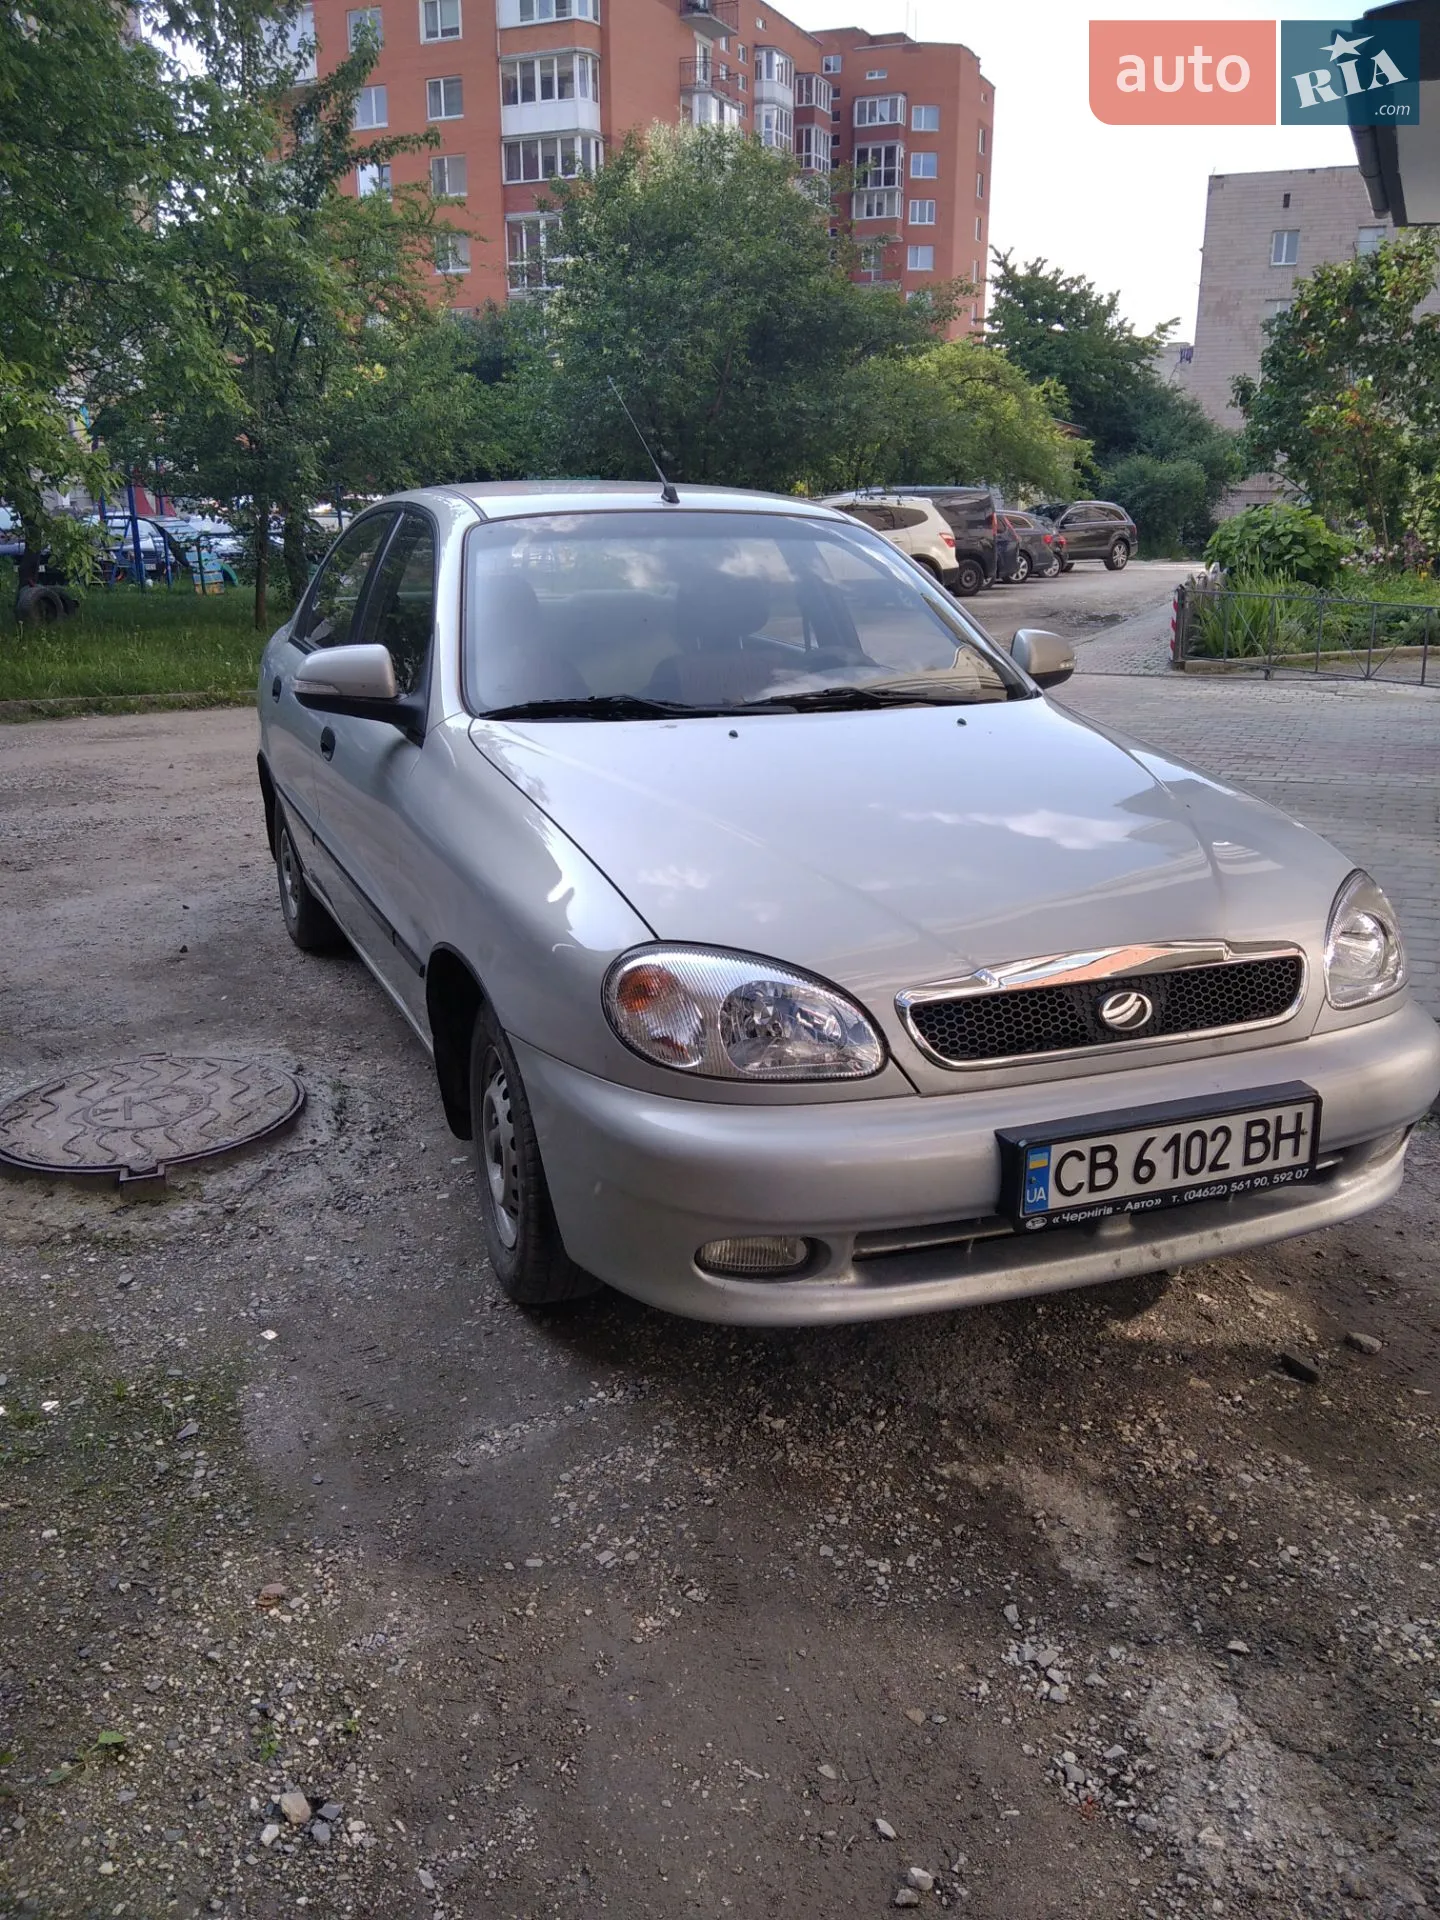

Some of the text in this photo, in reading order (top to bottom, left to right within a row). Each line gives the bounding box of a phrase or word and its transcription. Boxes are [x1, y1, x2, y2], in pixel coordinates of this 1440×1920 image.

[1054, 1112, 1303, 1197] CB 6102 BH
[1026, 1187, 1047, 1203] UA
[1184, 1184, 1227, 1201] (04622)
[1230, 1180, 1251, 1192] 561
[1253, 1176, 1270, 1188] 90,
[1273, 1172, 1293, 1184] 592
[1295, 1168, 1309, 1180] 07
